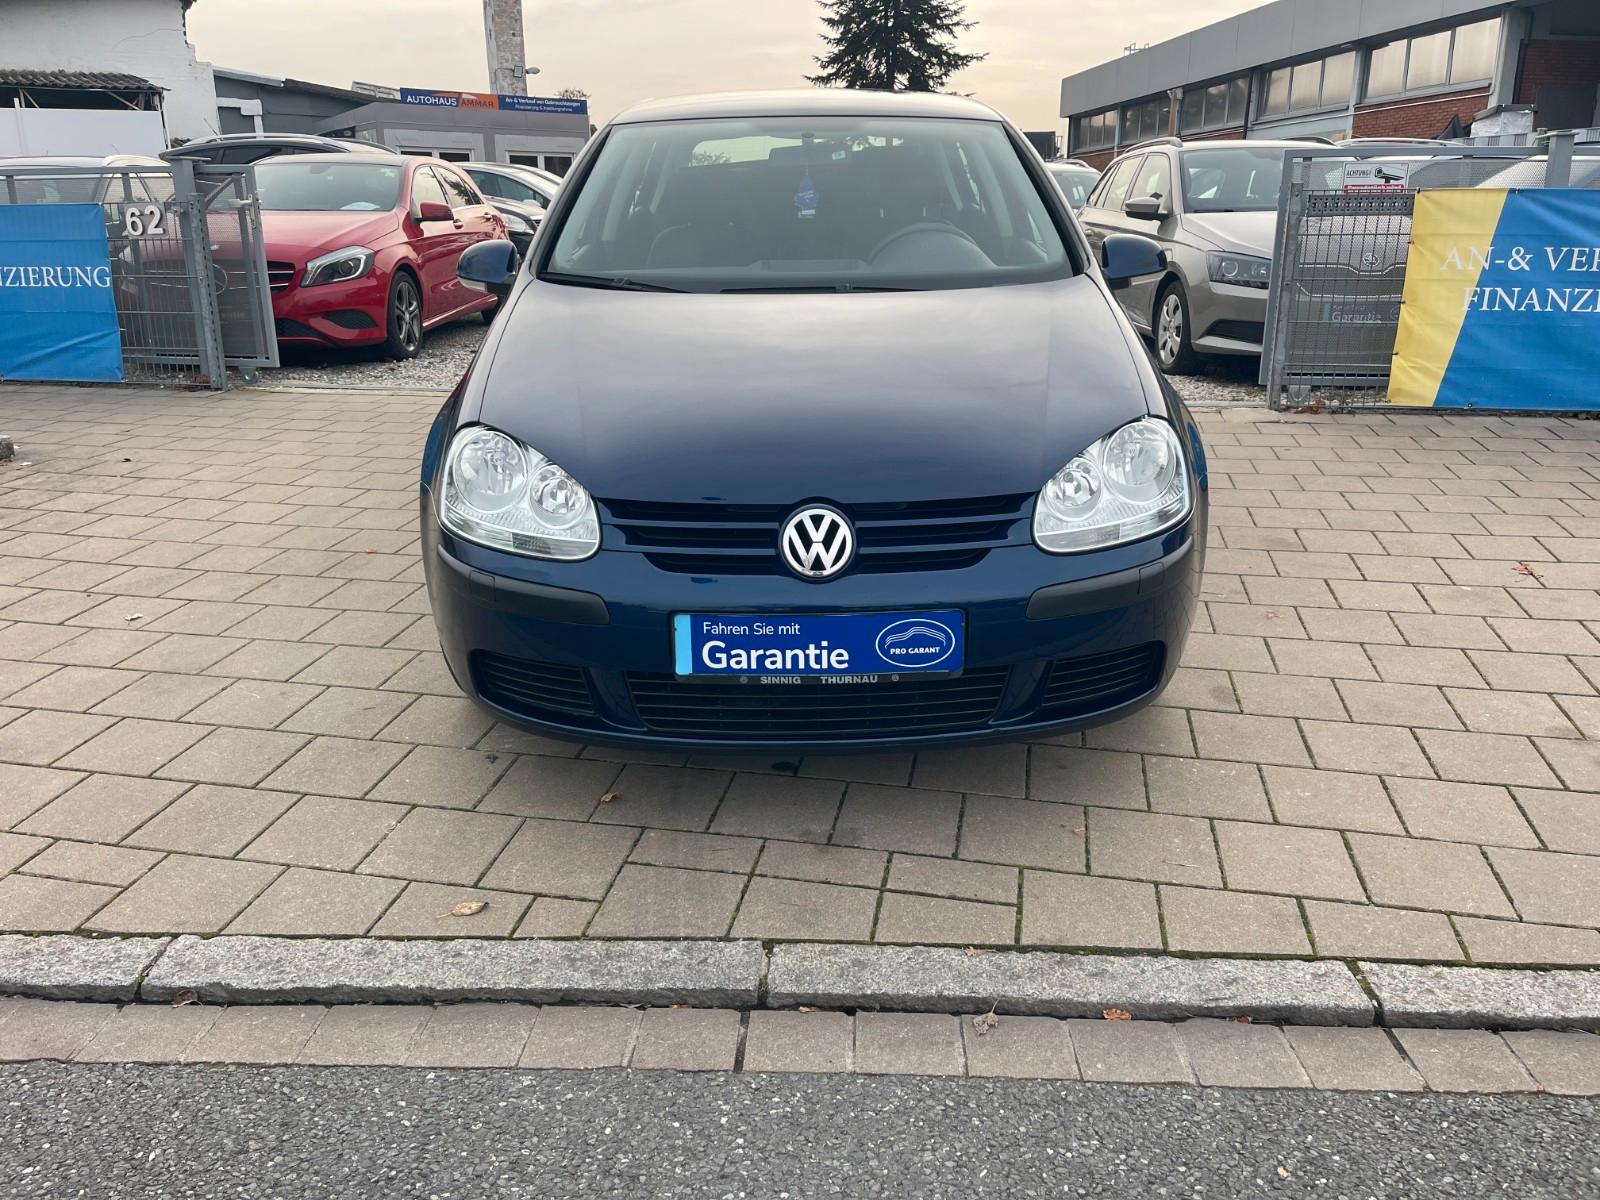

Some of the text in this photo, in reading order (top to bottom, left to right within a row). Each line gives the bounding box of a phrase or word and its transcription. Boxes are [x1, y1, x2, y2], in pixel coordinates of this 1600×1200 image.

[406, 95, 494, 108] AUTOHAUS AMMAR
[126, 205, 164, 236] 62
[783, 509, 852, 577] VW
[703, 621, 801, 635] Fahren Sie mit
[702, 641, 849, 669] Garantie
[908, 646, 940, 654] GARANT
[760, 675, 878, 684] SINNIG THURNAU
